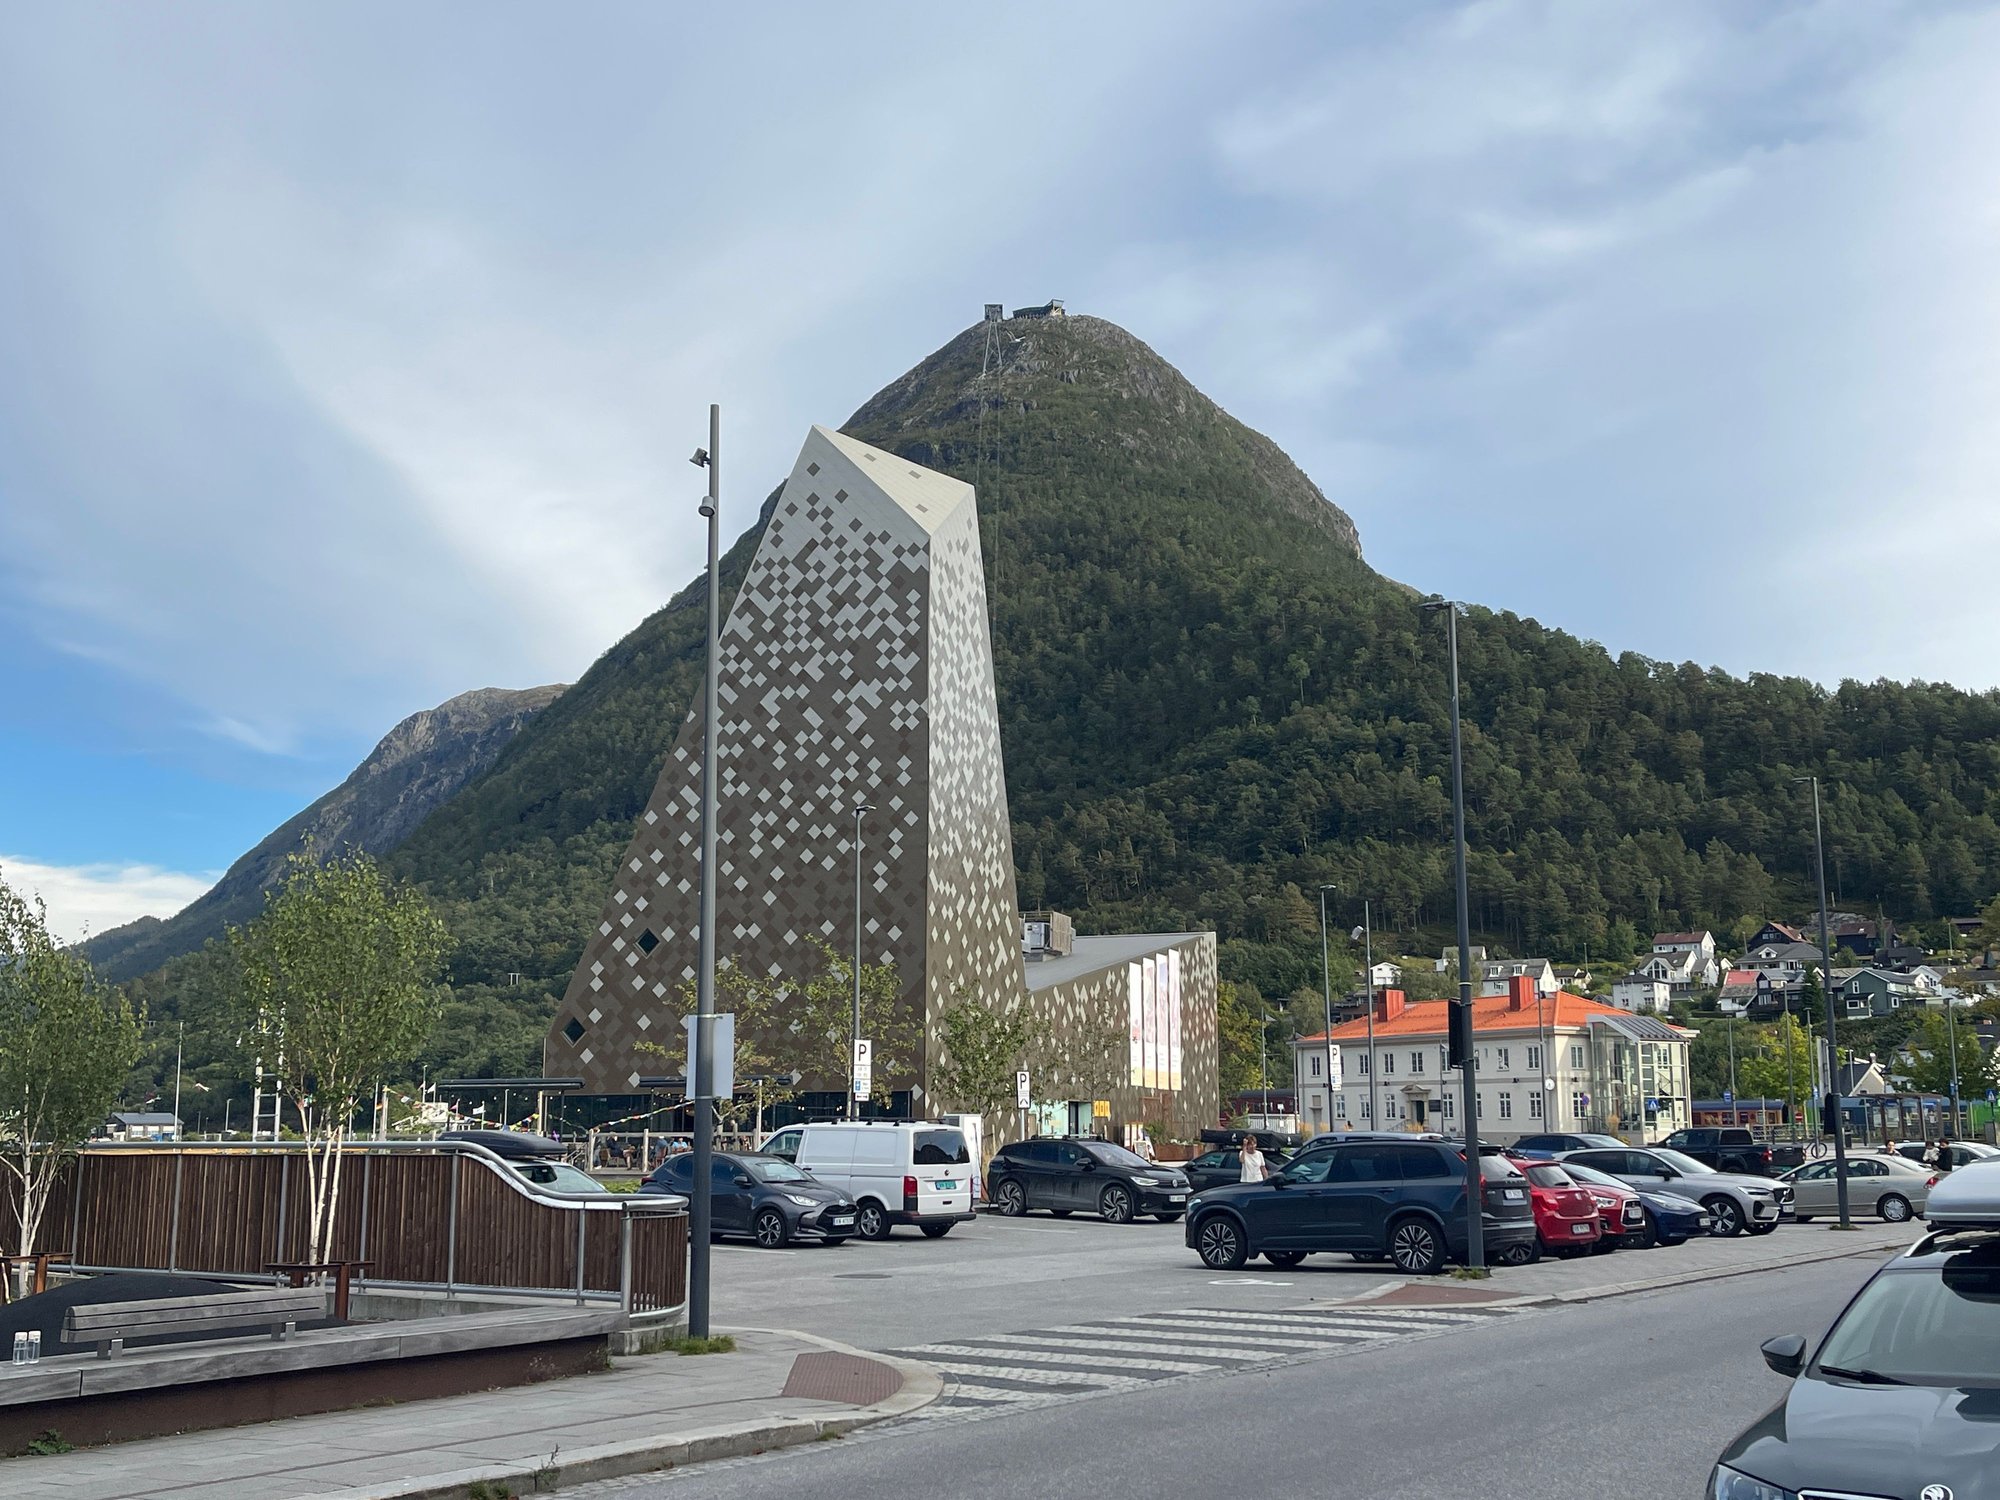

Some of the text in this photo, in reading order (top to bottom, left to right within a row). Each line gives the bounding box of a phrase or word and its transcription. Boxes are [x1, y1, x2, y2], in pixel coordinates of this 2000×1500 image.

[859, 1043, 867, 1061] P
[1332, 1047, 1338, 1061] P
[1019, 1073, 1027, 1089] P
